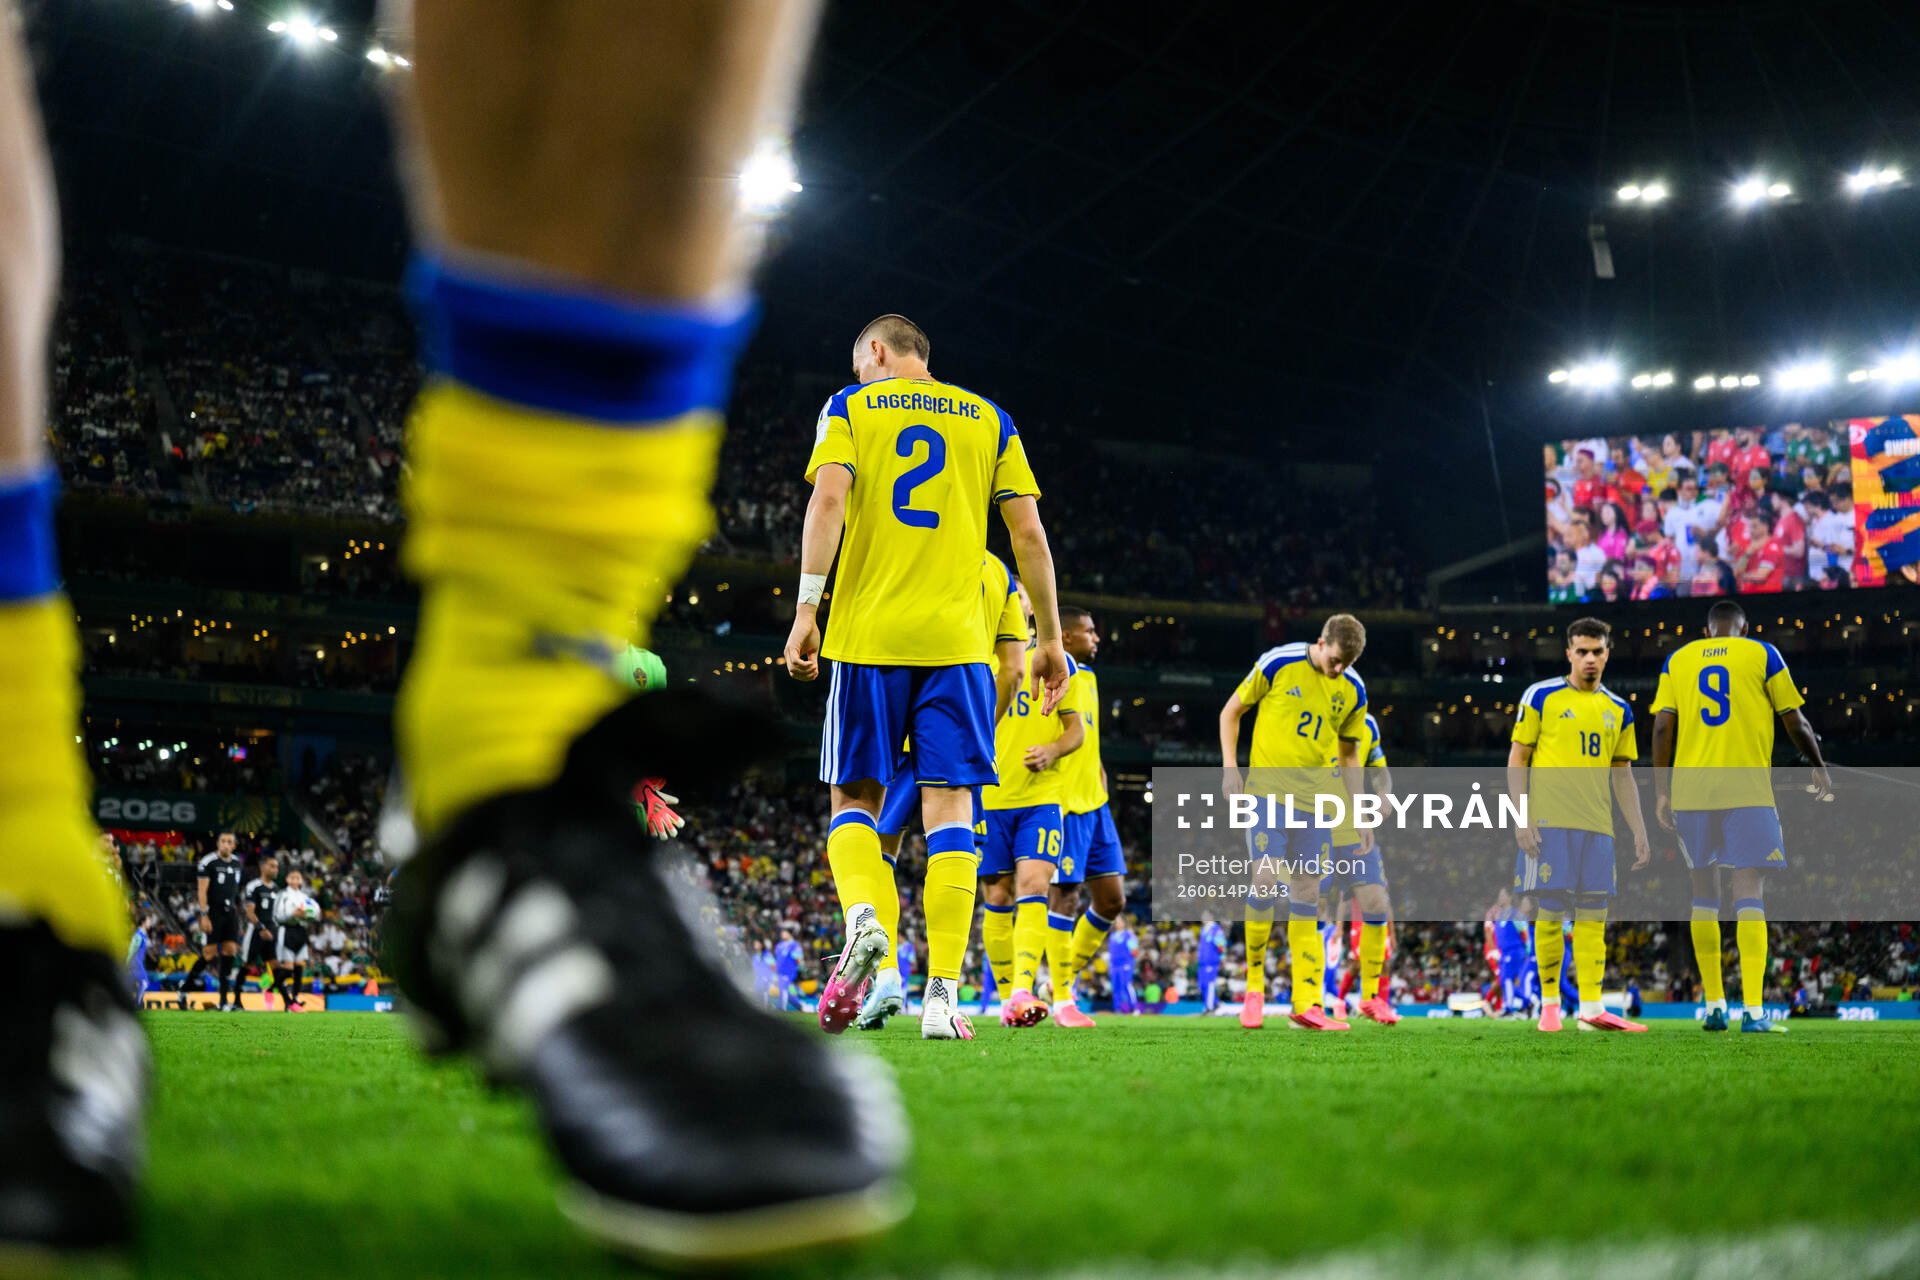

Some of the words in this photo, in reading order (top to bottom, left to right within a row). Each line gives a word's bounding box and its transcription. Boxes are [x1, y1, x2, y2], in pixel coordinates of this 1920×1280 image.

[866, 393, 981, 420] LAGERBIELKE
[892, 424, 946, 529] 2
[1702, 647, 1728, 658] ISAK
[1698, 665, 1731, 727] 9
[1297, 711, 1322, 740] 21
[1580, 731, 1601, 757] 18
[98, 798, 196, 823] 2026
[1037, 827, 1061, 857] 16
